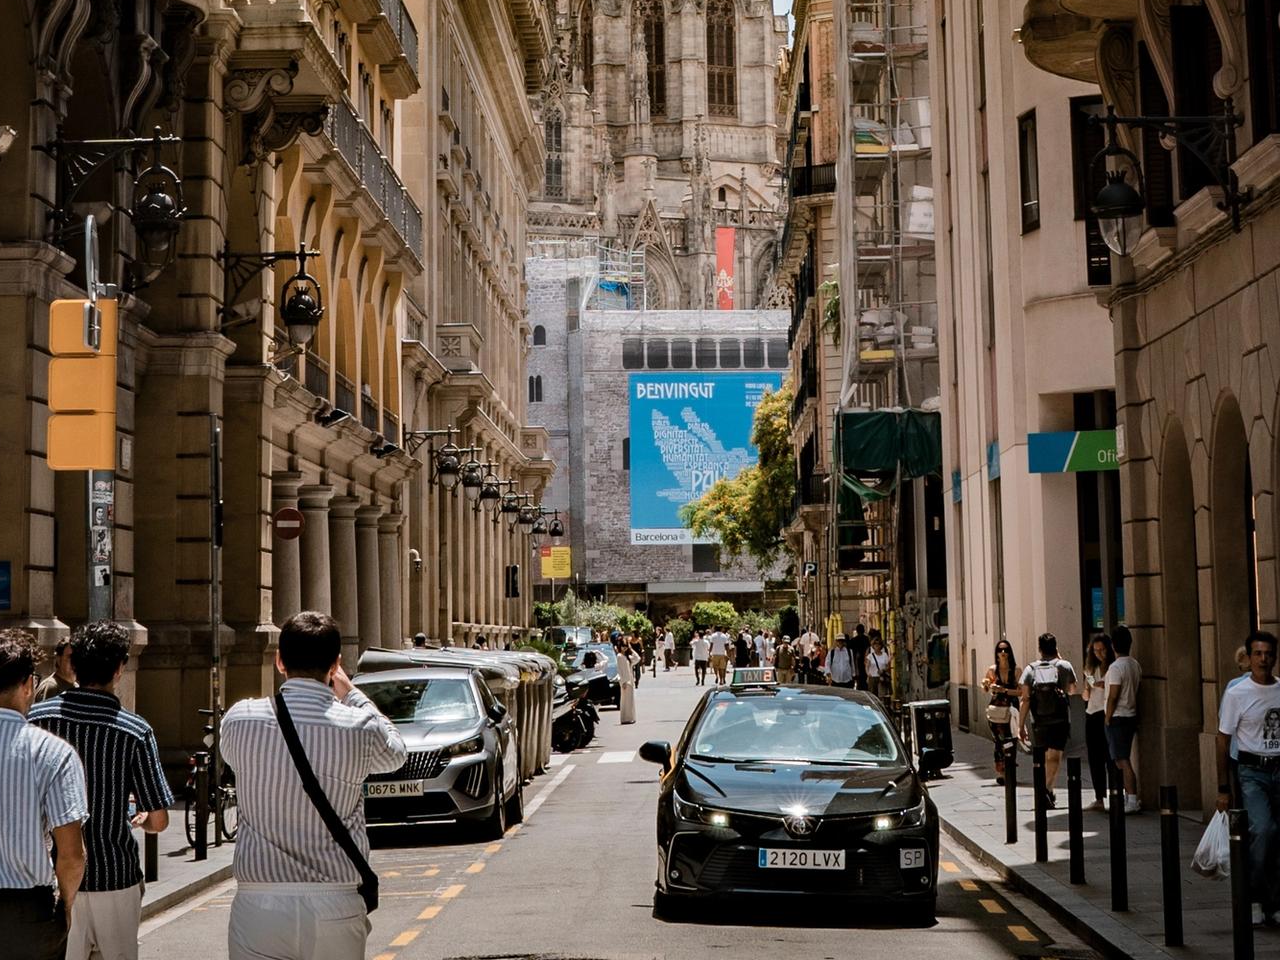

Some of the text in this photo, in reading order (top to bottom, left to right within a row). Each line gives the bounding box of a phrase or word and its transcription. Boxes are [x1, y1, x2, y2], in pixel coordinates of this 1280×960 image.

[637, 382, 715, 399] BENVINGUT
[654, 430, 687, 439] DIGNITAT
[660, 444, 704, 454] DIVERSITAT
[663, 453, 708, 463] HUMANITAT
[635, 532, 678, 542] Barcelona
[742, 671, 762, 681] TAXI
[368, 783, 420, 795] 0676 MNK
[770, 851, 841, 867] 2120 LVX
[903, 850, 922, 866] SP
